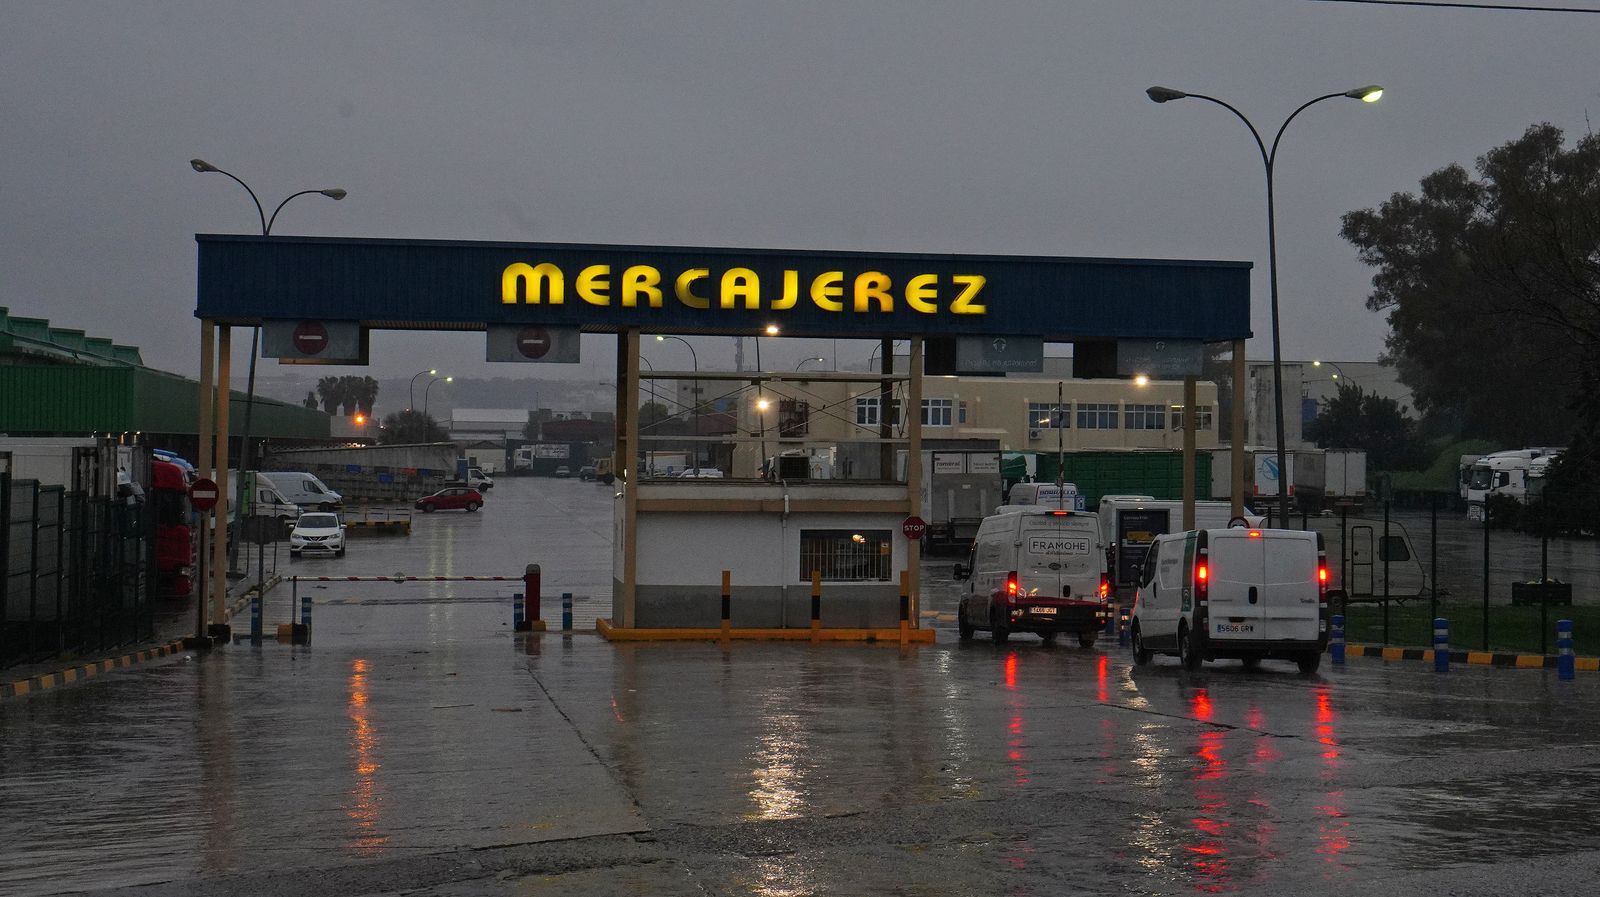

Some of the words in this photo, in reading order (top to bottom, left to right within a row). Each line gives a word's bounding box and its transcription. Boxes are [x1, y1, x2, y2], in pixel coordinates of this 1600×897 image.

[501, 262, 988, 314] MERCAJEREZ
[904, 524, 925, 532] STOP
[1032, 541, 1086, 551] FRAMOHE
